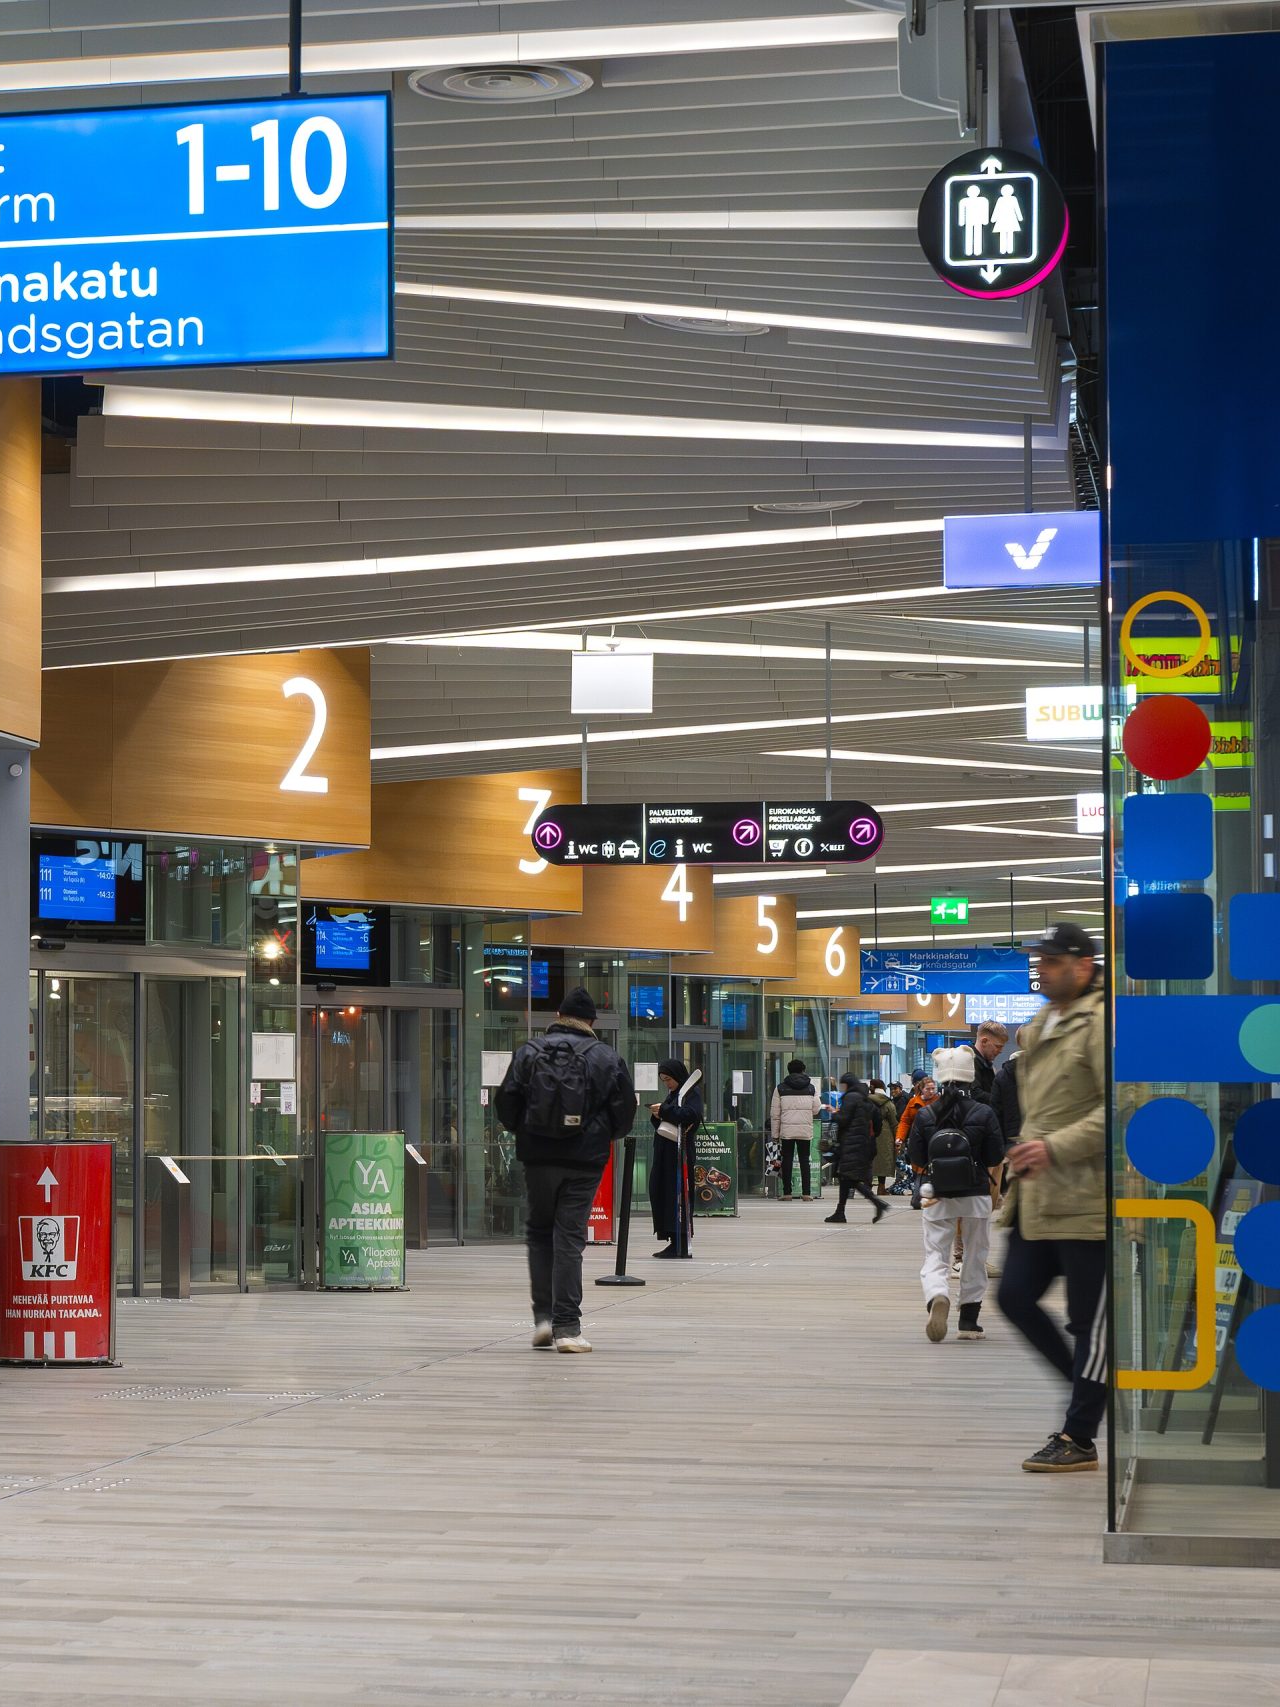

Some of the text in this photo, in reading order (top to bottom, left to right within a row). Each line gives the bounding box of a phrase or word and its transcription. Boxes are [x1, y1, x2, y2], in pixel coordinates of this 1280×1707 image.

[176, 115, 349, 215] 1-10
[279, 676, 330, 795] 2
[578, 844, 598, 854] WC
[692, 843, 712, 853] WC
[40, 868, 52, 882] 111
[40, 887, 52, 901] 111
[660, 863, 693, 922] 4
[756, 895, 779, 955] 5
[825, 926, 846, 977] 6
[909, 952, 969, 961] Markkinakatu
[356, 1160, 390, 1193] YA
[350, 1202, 393, 1215] ASIAA
[361, 1246, 401, 1258] Yliopiston
[29, 1264, 69, 1278] KFC
[51, 1294, 94, 1304] PURTAVAA
[5, 1308, 102, 1319] IHAN NURKAN TAKANA.
